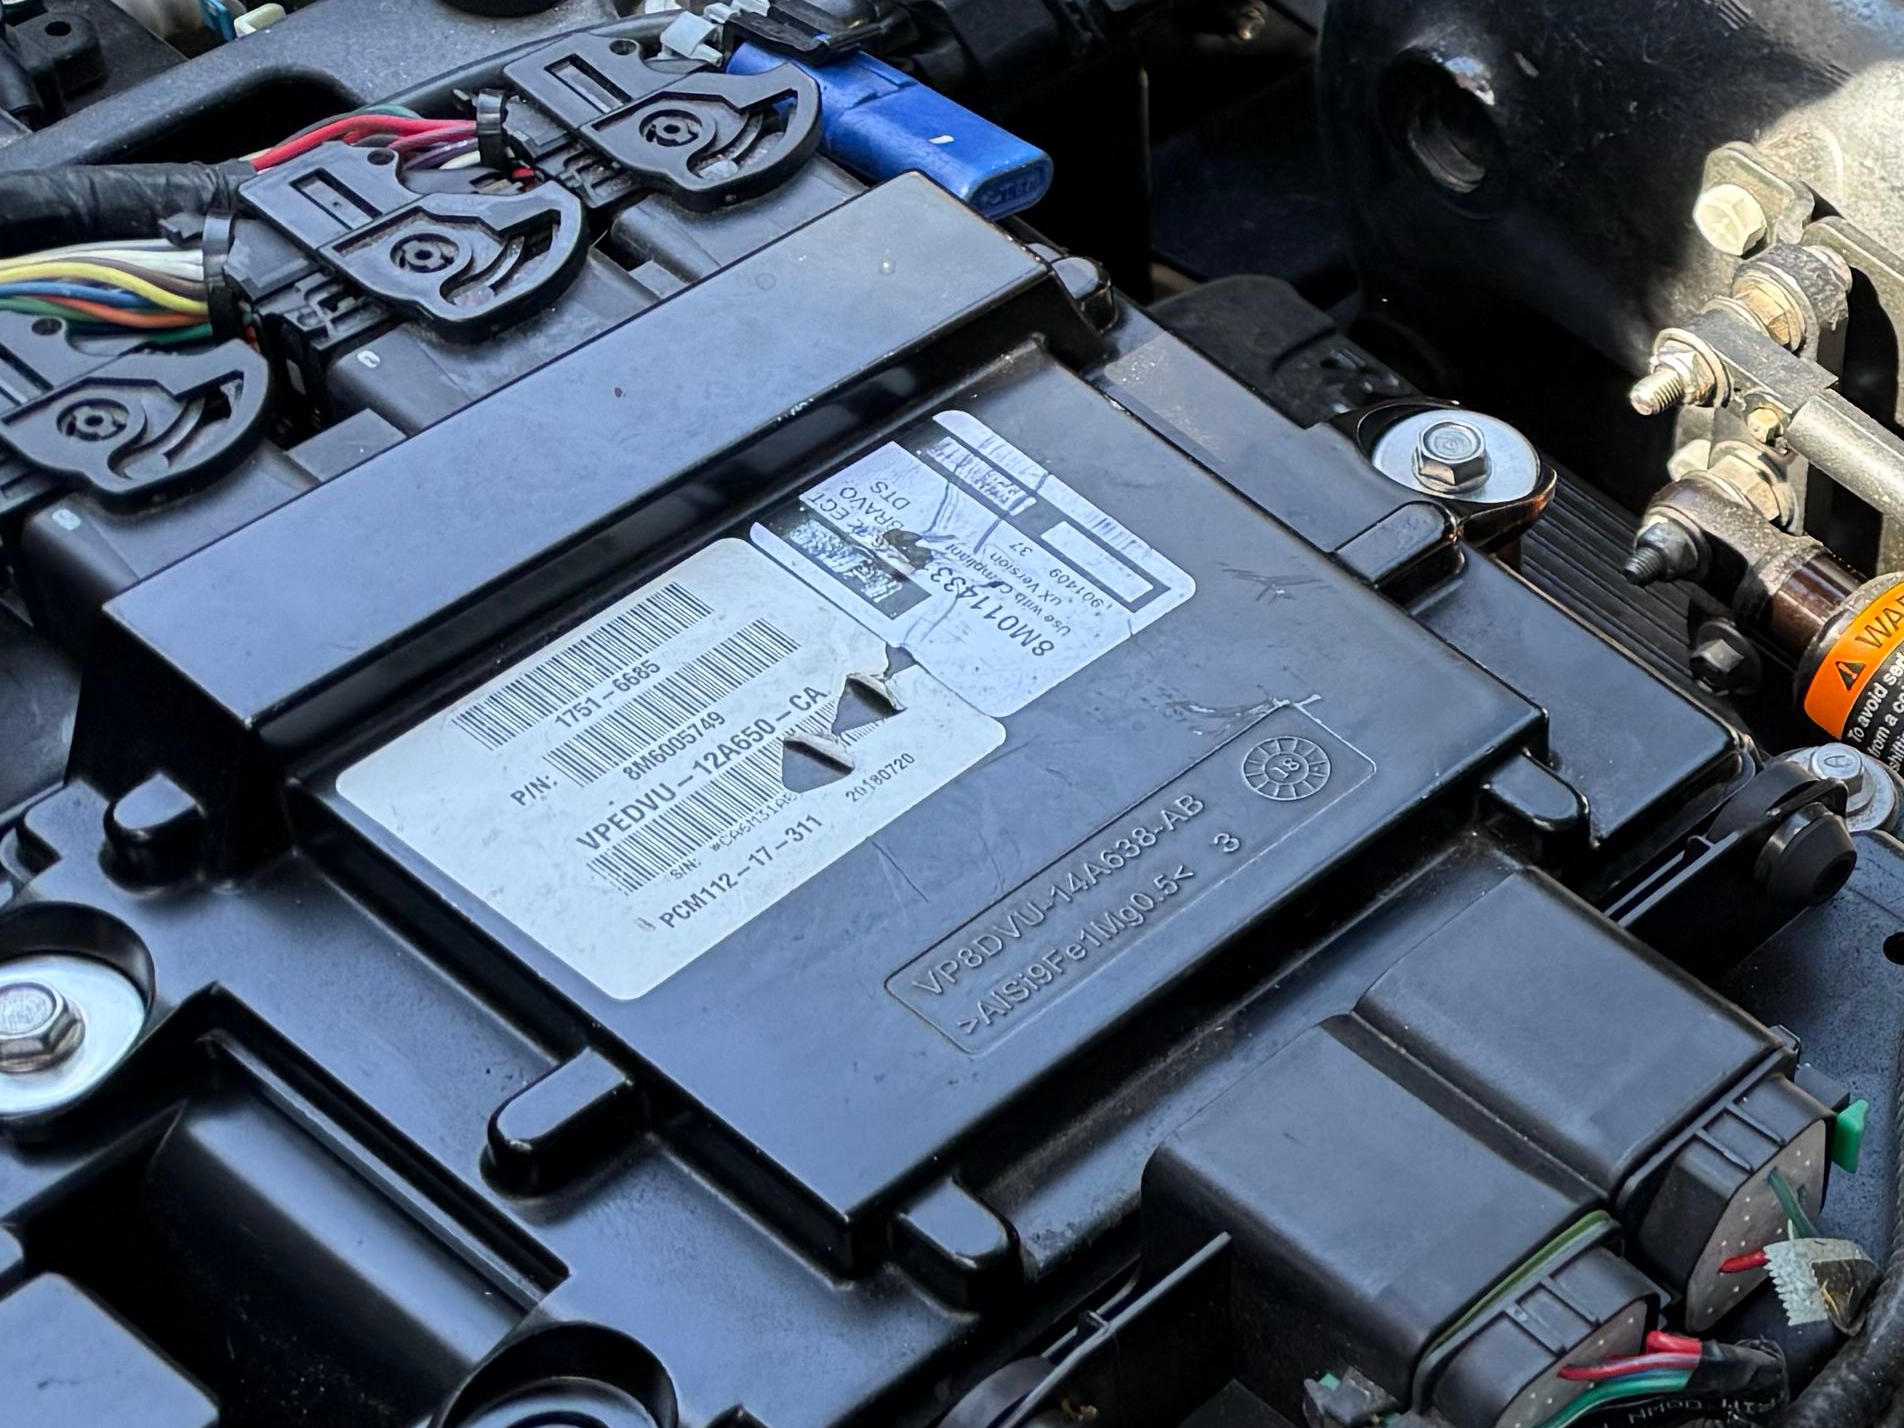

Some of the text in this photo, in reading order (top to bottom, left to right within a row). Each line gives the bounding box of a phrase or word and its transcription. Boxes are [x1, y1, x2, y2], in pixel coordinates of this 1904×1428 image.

[867, 477, 912, 512] DTS
[943, 539, 1014, 596] Cmpliant
[1007, 536, 1033, 559] 37
[985, 549, 1042, 594] Version
[920, 558, 1057, 659] 8M011433
[1041, 611, 1071, 637] Use
[1854, 681, 1890, 728] avoid
[622, 708, 728, 783] 8M6005749
[1846, 724, 1866, 744] To
[1866, 725, 1893, 757] from
[1883, 712, 1900, 728] a
[509, 767, 559, 811] P/N:
[843, 748, 917, 806] 20180720
[1270, 756, 1301, 779] 18
[1210, 825, 1244, 859] 3
[667, 852, 704, 884] S/N:
[910, 788, 1208, 999] VP8DVU-14A638-AB
